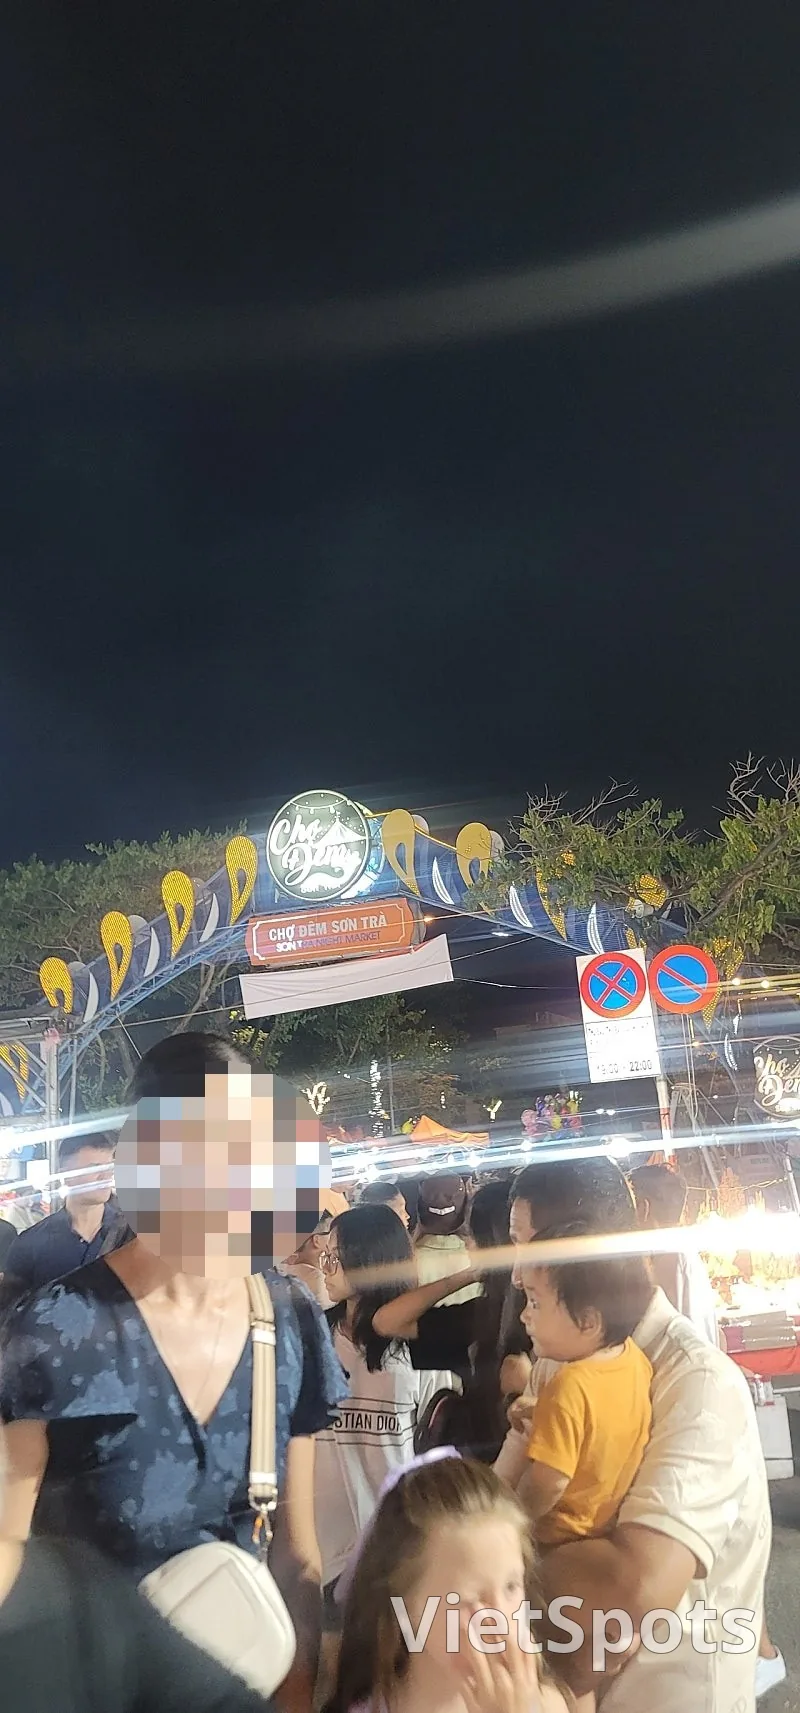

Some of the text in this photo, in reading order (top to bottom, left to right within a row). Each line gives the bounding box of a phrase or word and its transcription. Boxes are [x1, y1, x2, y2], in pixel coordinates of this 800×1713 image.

[268, 911, 387, 941] CHỢ ĐÊM SƠN TRÀ
[345, 930, 381, 943] MARKET
[629, 1059, 652, 1072] 22:00
